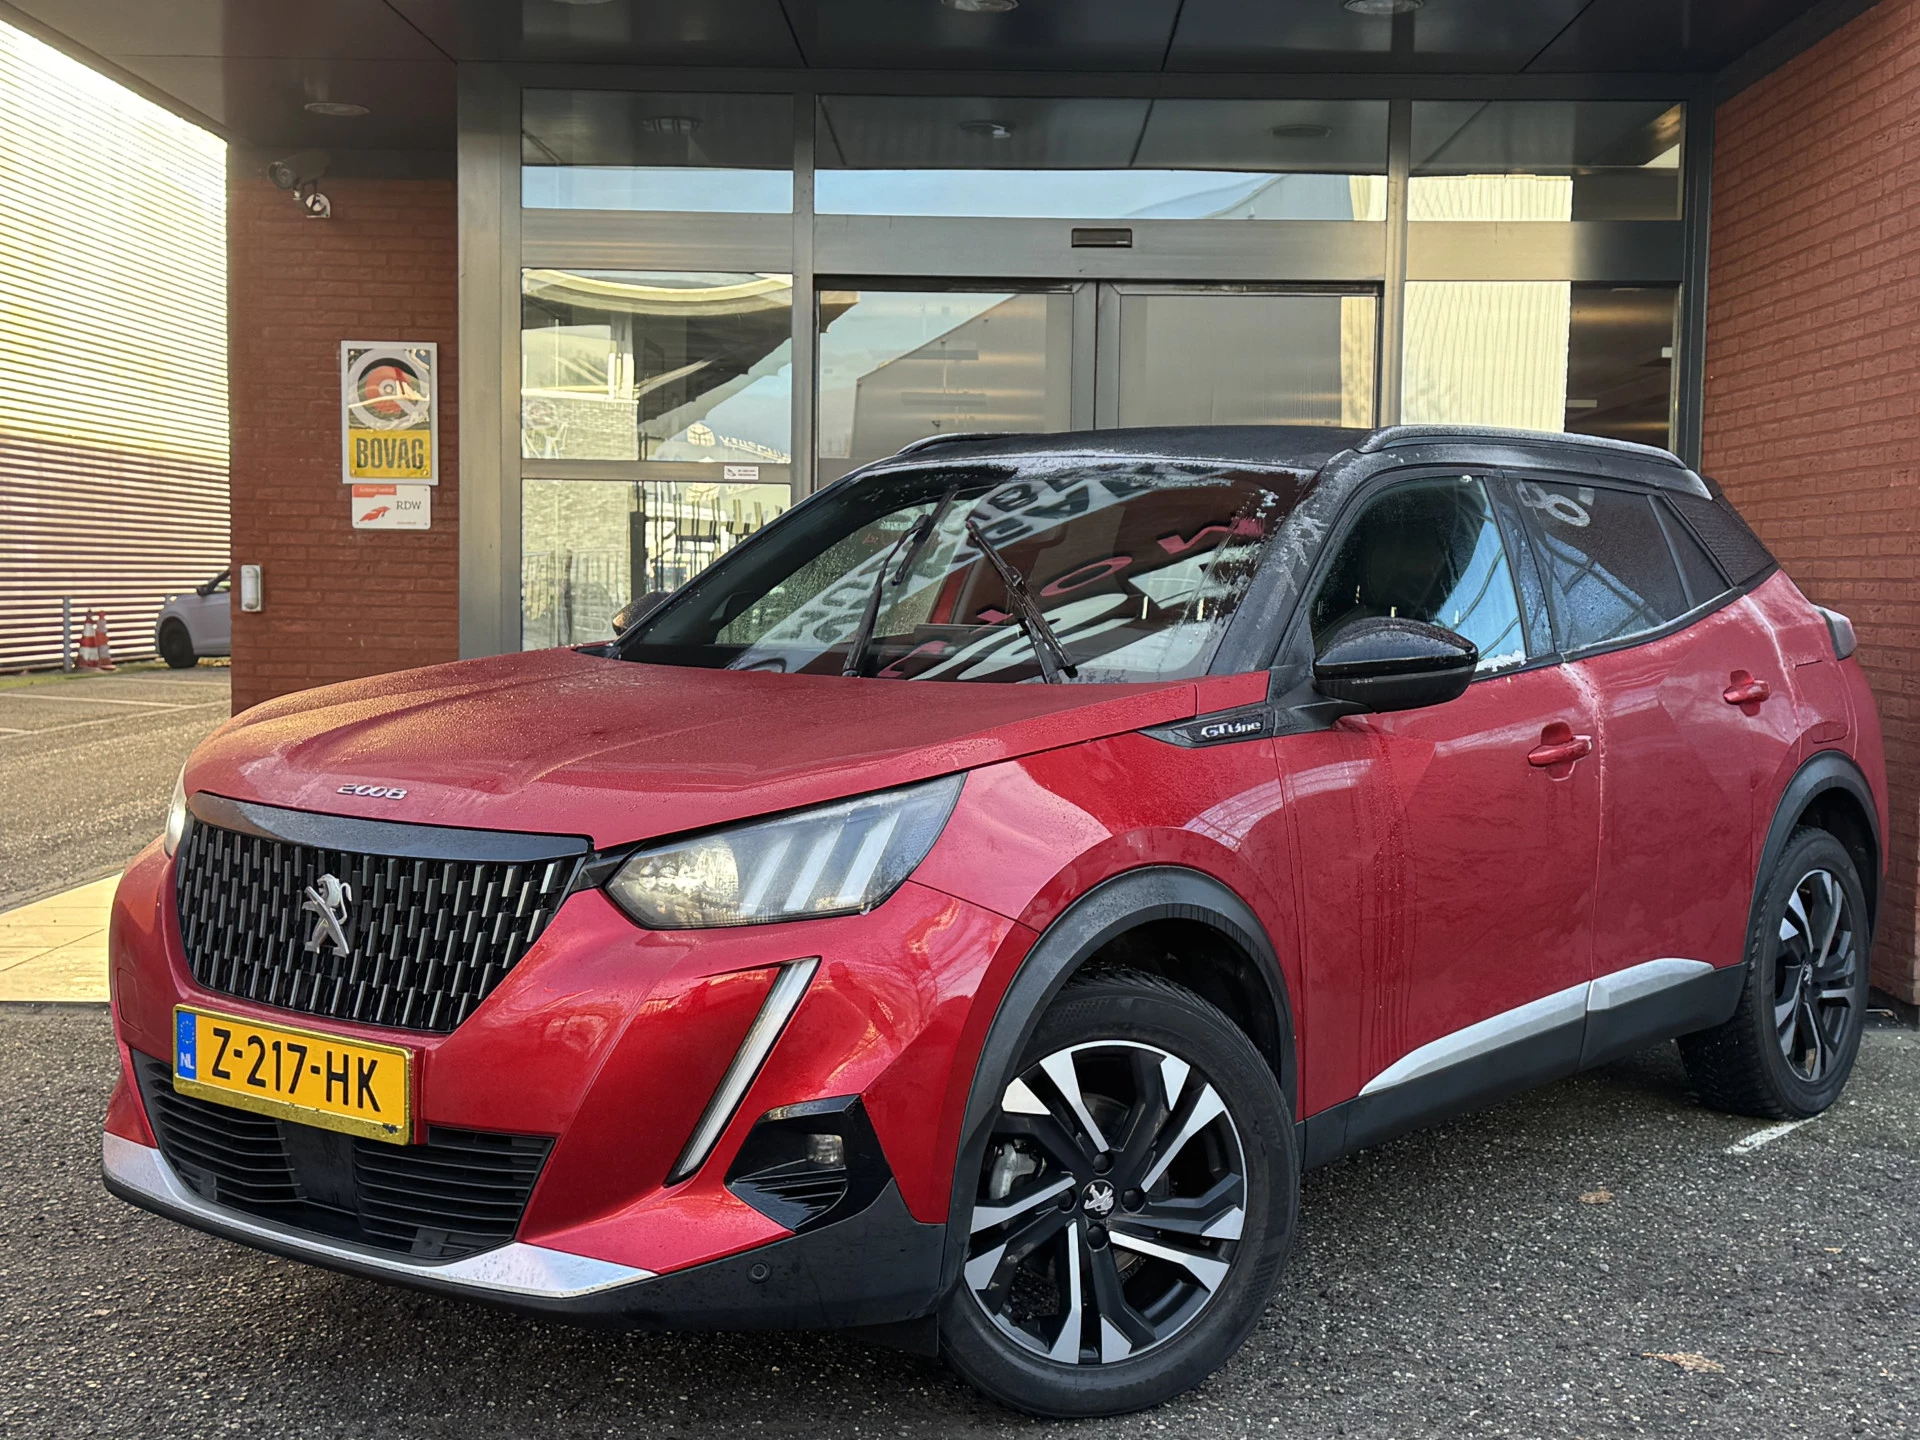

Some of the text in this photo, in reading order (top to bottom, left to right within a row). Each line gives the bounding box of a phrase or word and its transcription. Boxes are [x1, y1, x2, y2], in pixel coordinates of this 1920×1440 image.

[356, 437, 424, 469] BOVAG
[396, 500, 422, 511] RDW
[336, 783, 408, 800] 2008
[180, 1051, 196, 1071] NL
[211, 1027, 381, 1113] Z-217-HK
